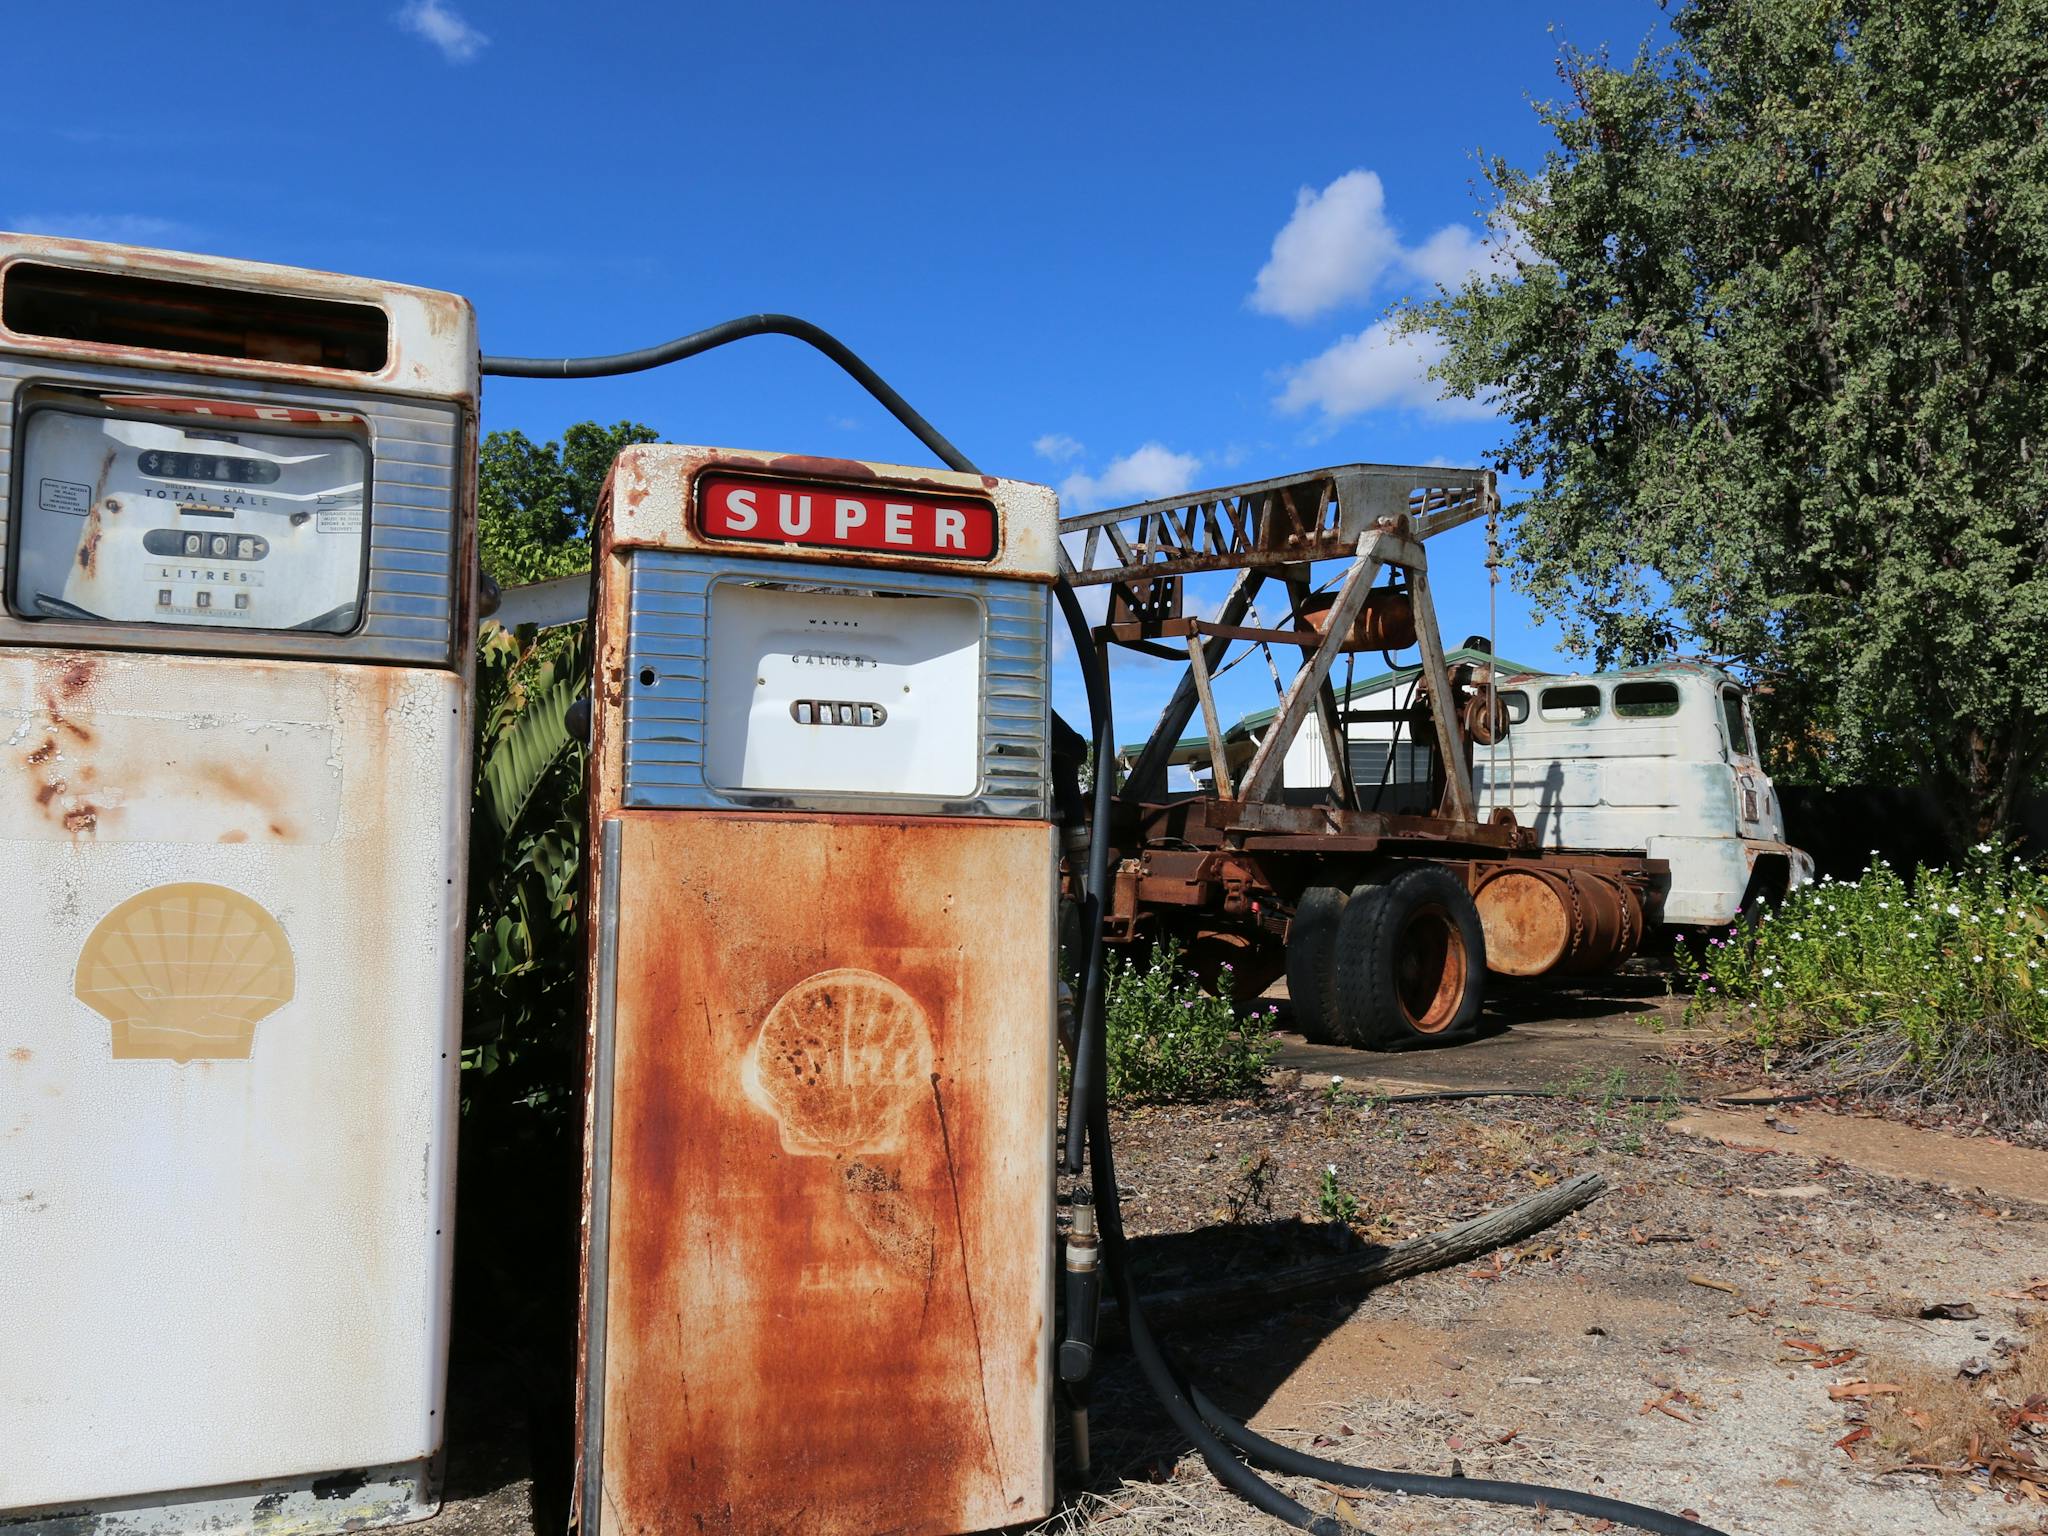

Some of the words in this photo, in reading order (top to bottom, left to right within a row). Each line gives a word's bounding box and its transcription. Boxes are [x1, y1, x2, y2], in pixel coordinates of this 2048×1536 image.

[144, 489, 207, 502] TOTAL
[223, 494, 269, 506] SALE
[725, 489, 967, 550] SUPER
[162, 568, 248, 582] LITRES
[809, 619, 859, 627] WAYNE
